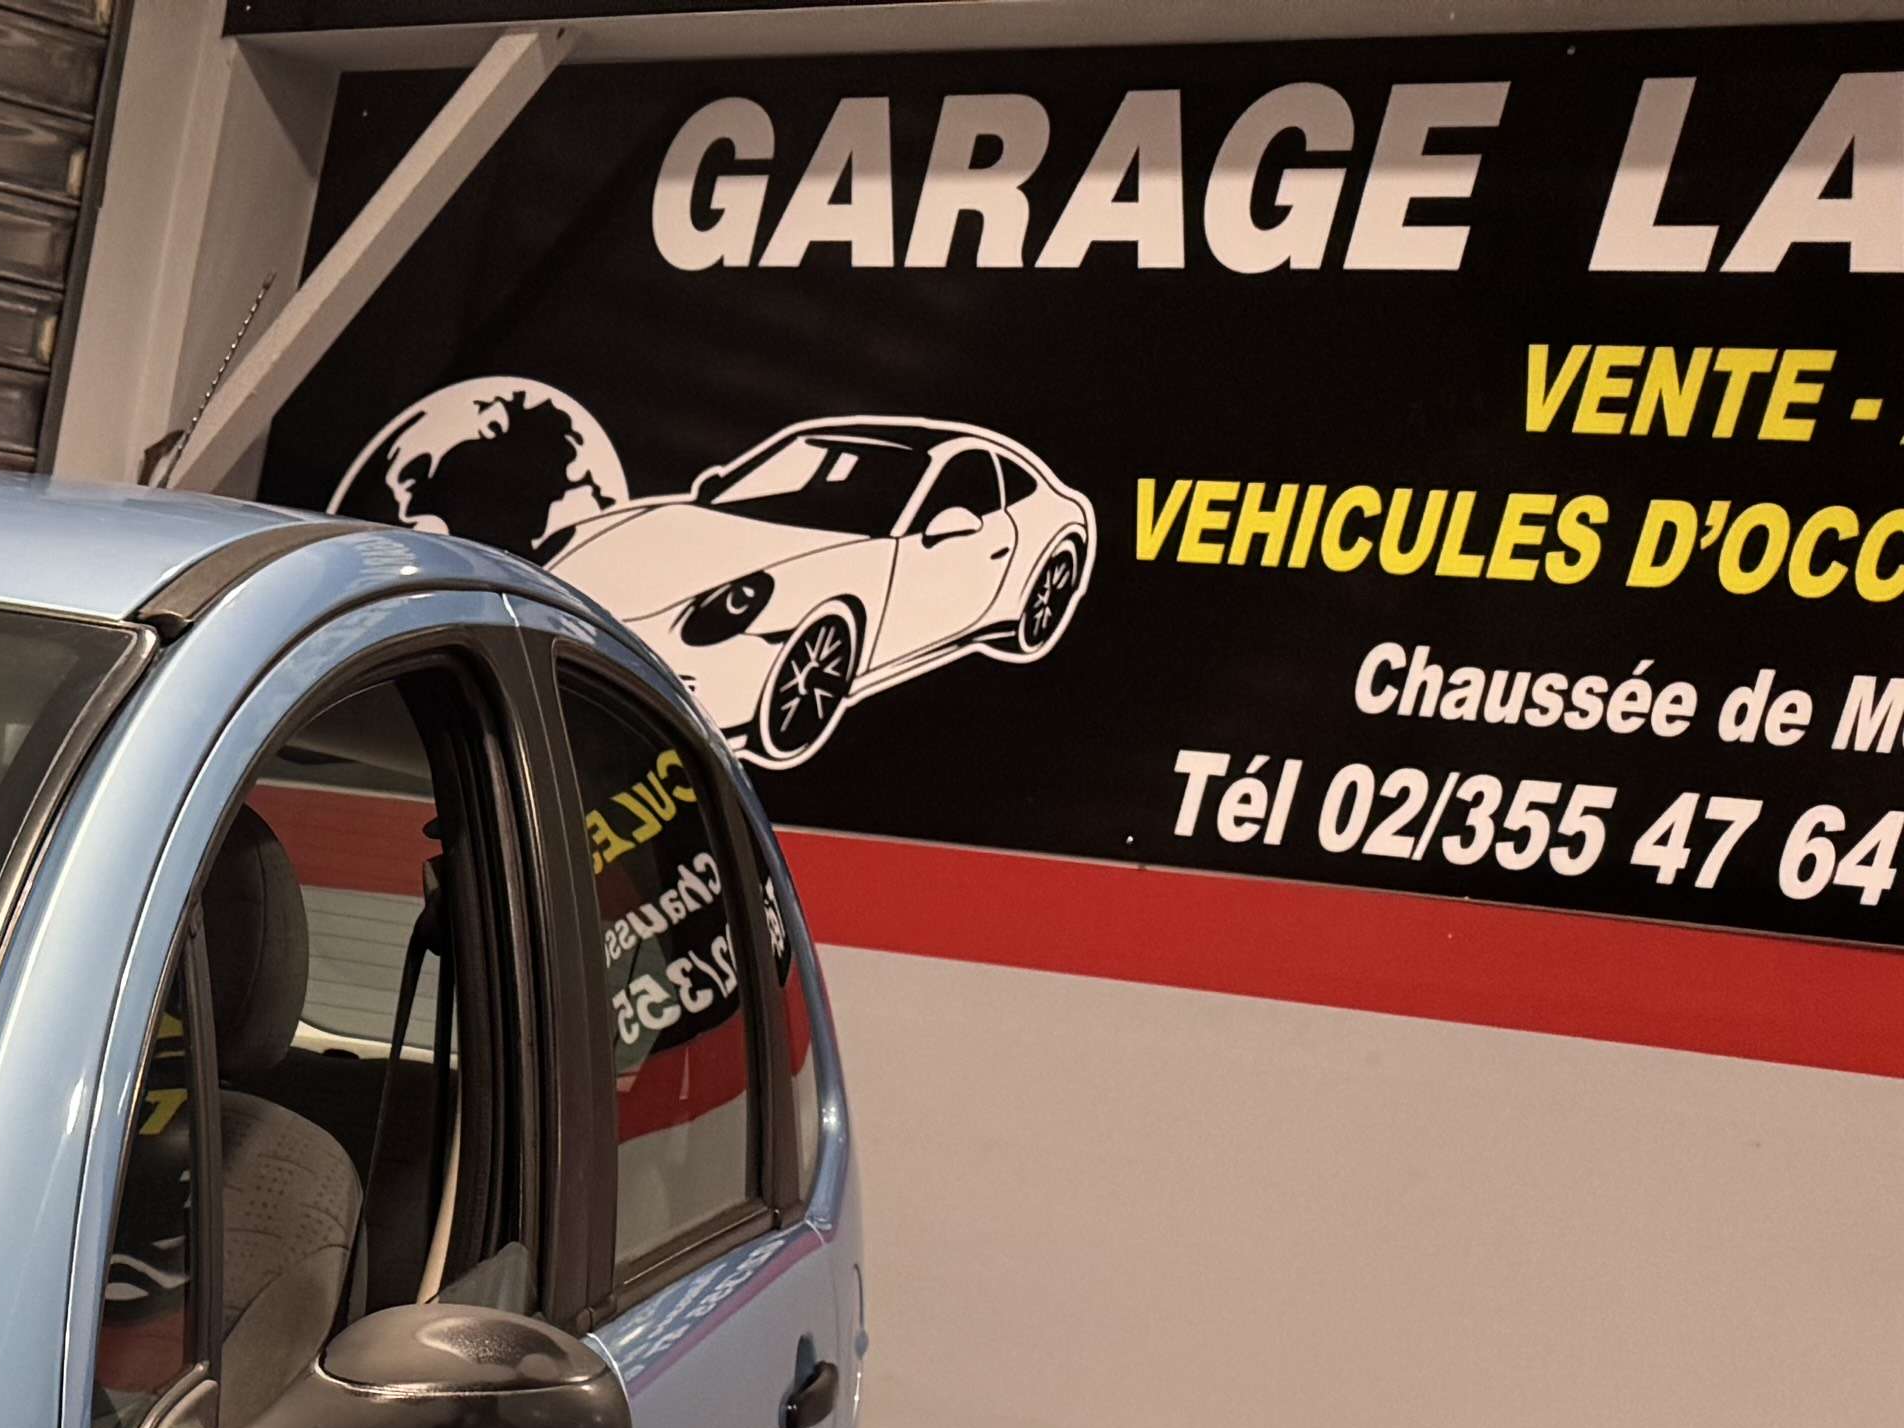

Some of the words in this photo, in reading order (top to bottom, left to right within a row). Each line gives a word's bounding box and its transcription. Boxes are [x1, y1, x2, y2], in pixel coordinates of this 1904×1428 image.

[652, 82, 1510, 274] GARAGE
[1526, 344, 1836, 441] VENTE
[1851, 399, 1882, 420] -
[1136, 478, 1609, 584] VEHICULES
[1355, 642, 1697, 737] Chaussée
[1718, 669, 1812, 746] de
[1832, 675, 1904, 753] M
[1174, 750, 1302, 845] Tél
[1319, 764, 1617, 875] 02/355
[1631, 792, 1763, 888] 47
[1779, 805, 1904, 905] 64
